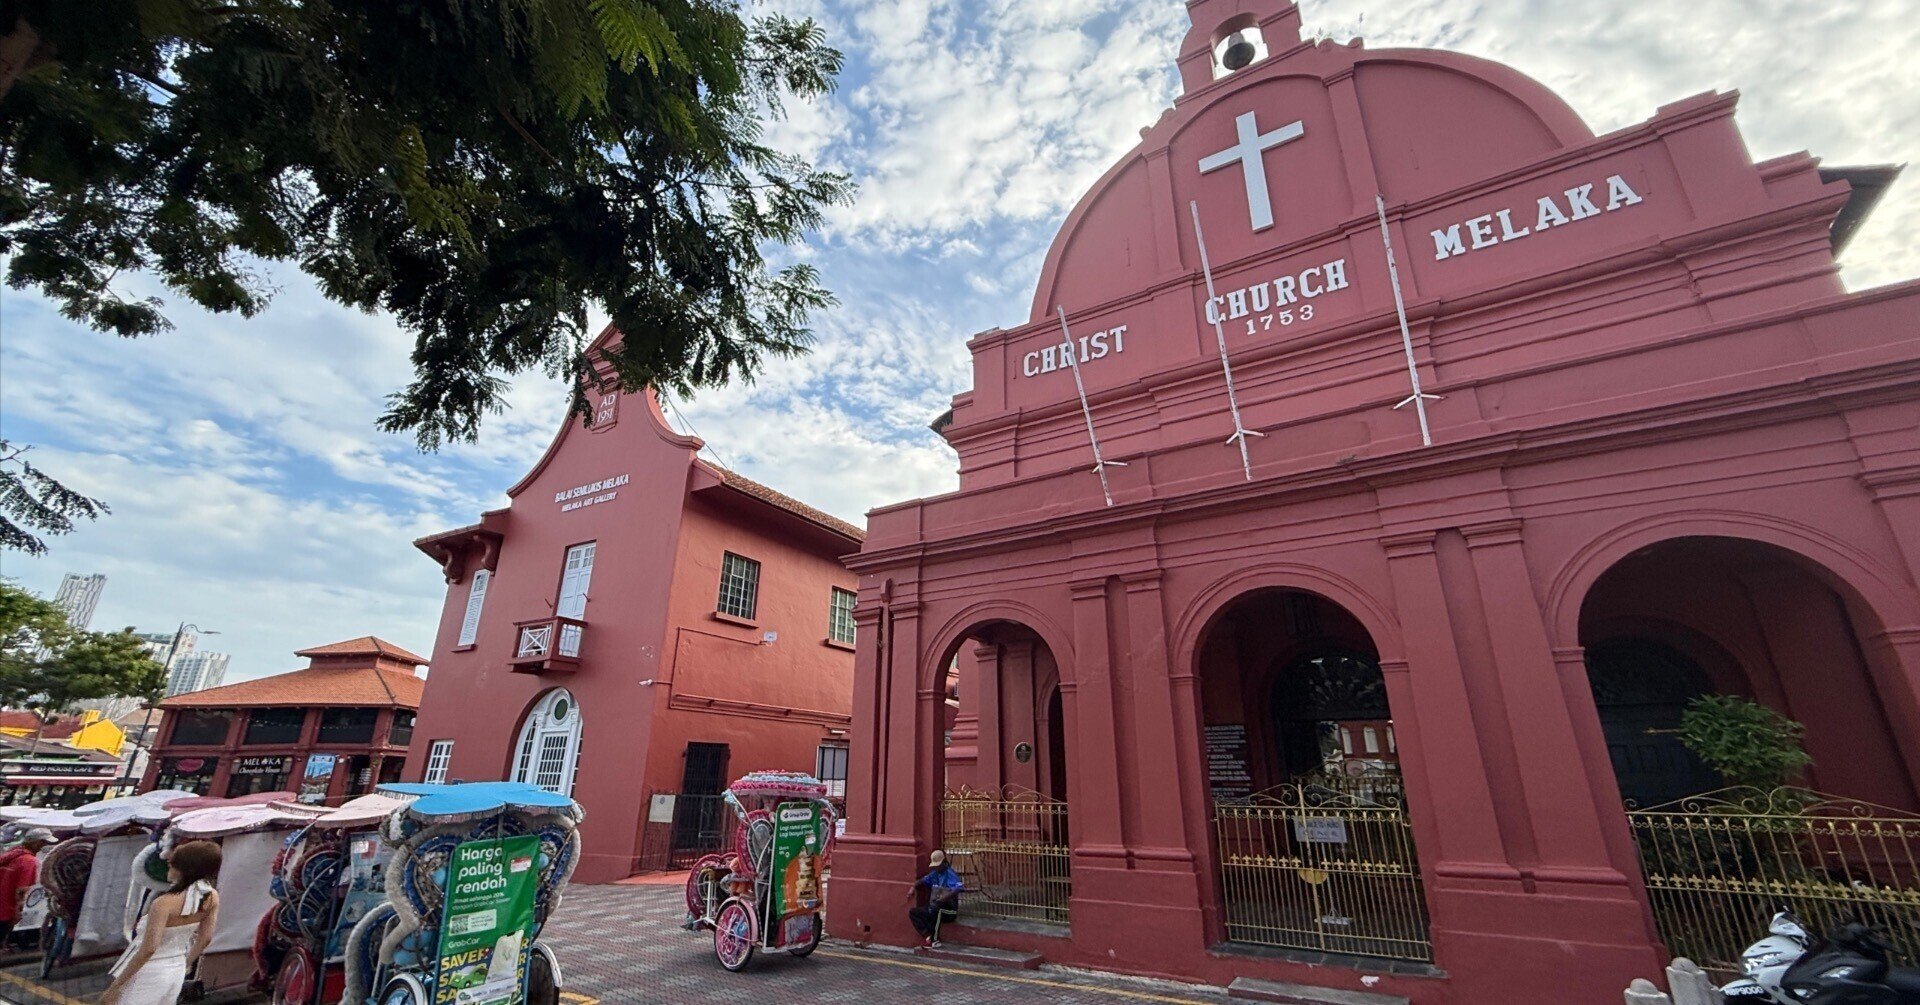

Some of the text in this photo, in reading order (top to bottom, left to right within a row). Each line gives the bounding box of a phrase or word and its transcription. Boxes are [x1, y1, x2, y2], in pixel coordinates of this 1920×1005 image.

[1023, 174, 1643, 377] CHRIST CHURCH MELAKA
[1246, 304, 1314, 335] 1753
[600, 394, 616, 407] AD
[555, 489, 573, 503] BALAI
[602, 474, 629, 490] MELAKA
[561, 491, 617, 512] MELAKA ART GALLERY
[461, 847, 503, 861] Harga
[458, 862, 503, 881] paling
[455, 875, 507, 894] rendah
[448, 937, 480, 949] GrabCar
